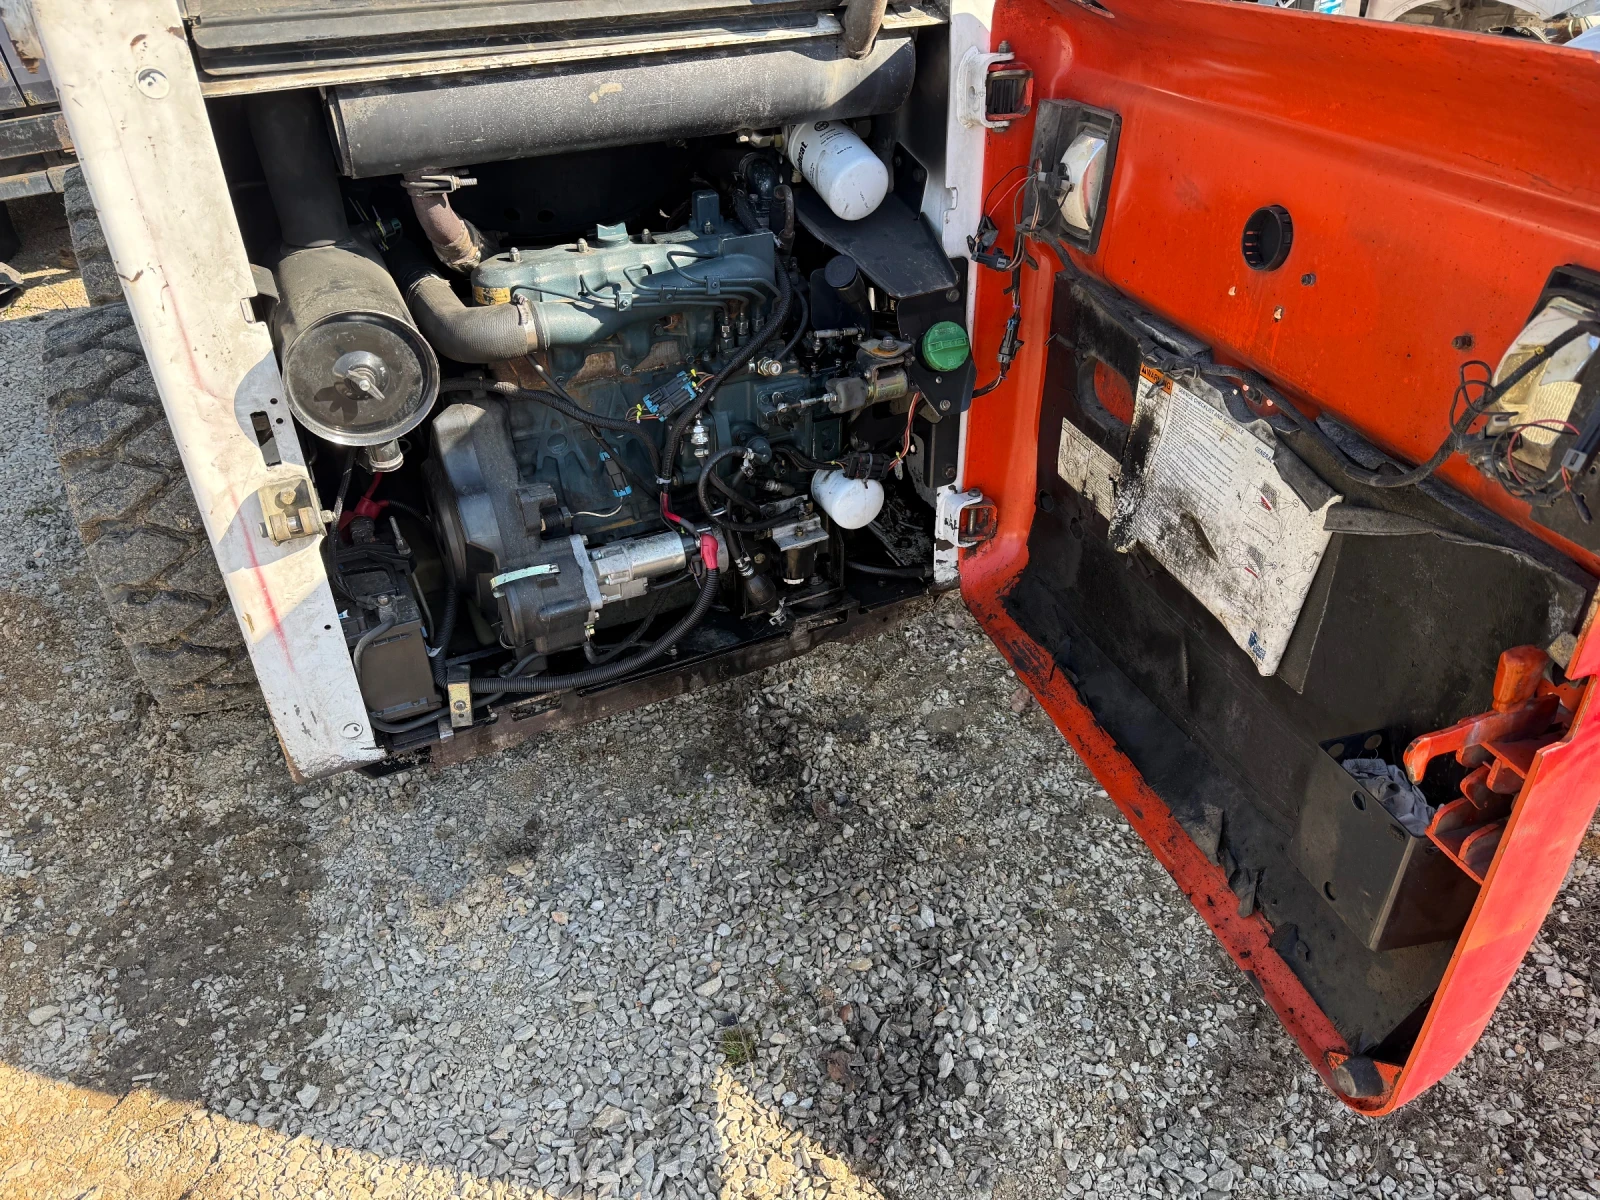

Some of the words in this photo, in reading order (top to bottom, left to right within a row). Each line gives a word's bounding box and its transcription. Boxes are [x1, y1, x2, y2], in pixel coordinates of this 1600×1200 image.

[1146, 368, 1171, 390] WARNG
[1179, 387, 1194, 401] SERVICE
[1193, 397, 1214, 415] CHECKLIST
[1223, 417, 1245, 435] SCHEDULE
